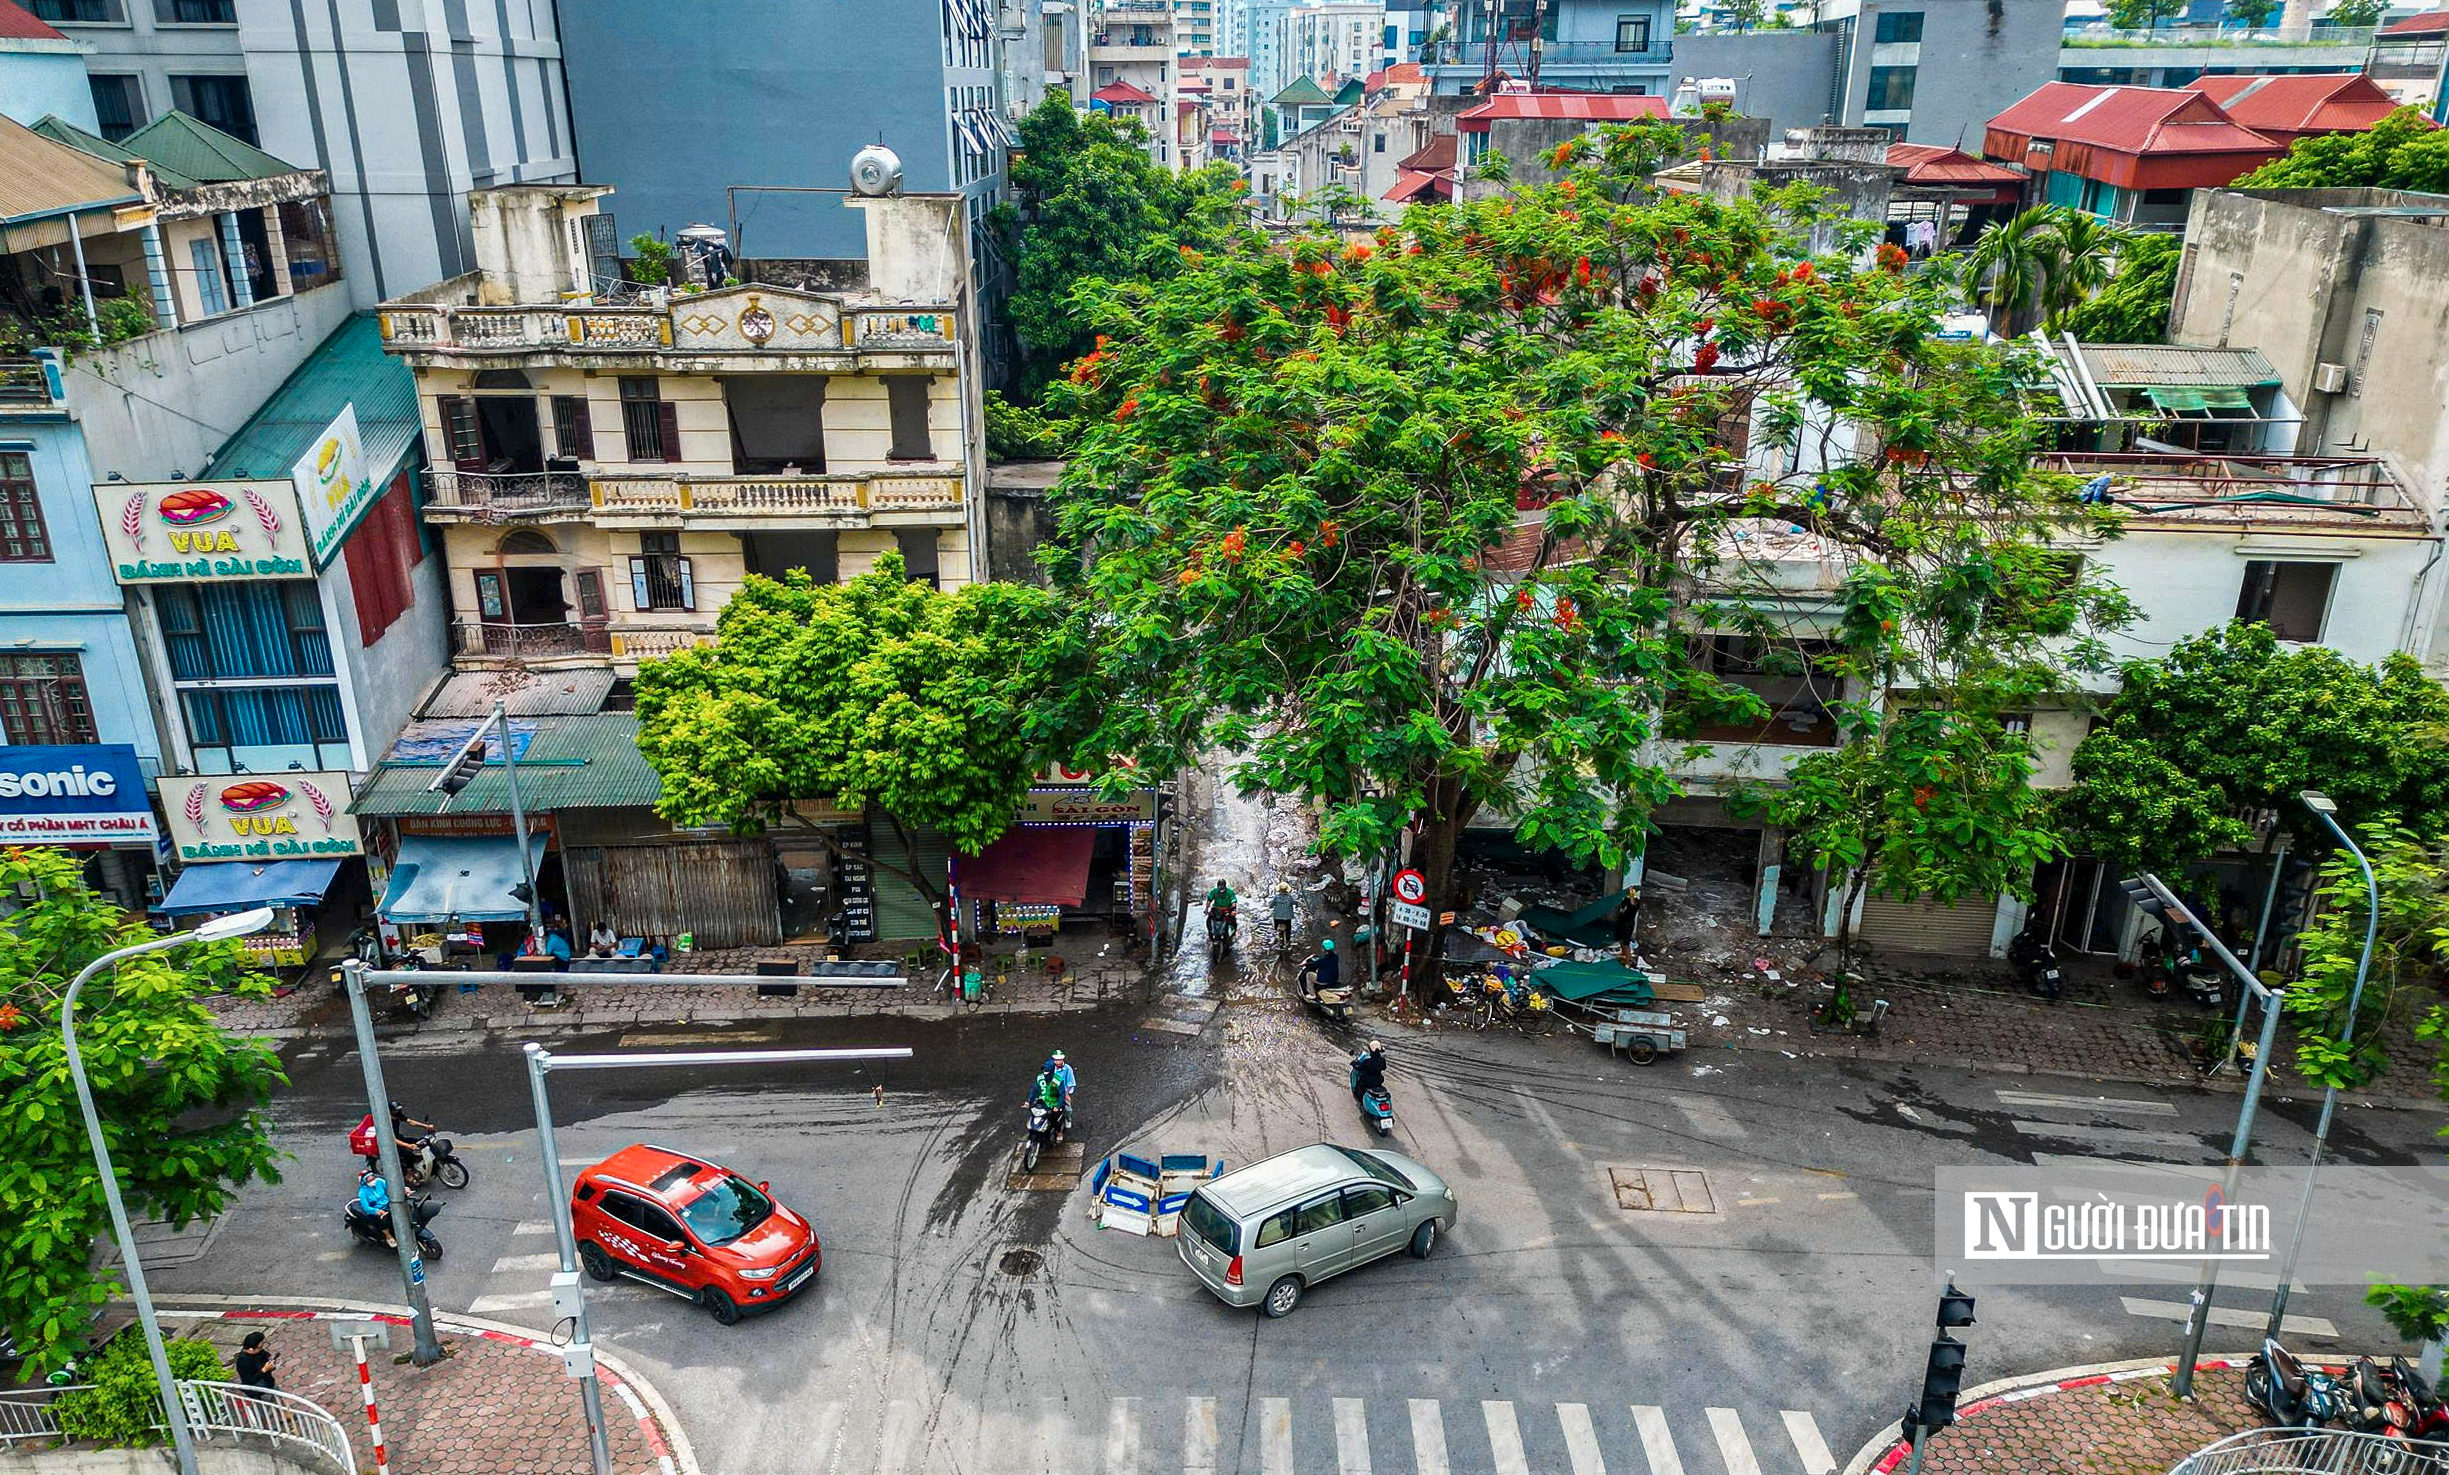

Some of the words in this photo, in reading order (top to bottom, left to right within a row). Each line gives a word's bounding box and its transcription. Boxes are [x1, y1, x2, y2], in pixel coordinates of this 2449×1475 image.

[168, 530, 240, 554] VUA
[119, 559, 184, 580] BÁNH
[185, 557, 212, 577] MÌ
[214, 556, 254, 576] SÀI
[255, 555, 304, 576] GÒN
[0, 764, 117, 798] sonic
[1052, 804, 1090, 814] SÀI
[1094, 804, 1141, 813] GÒN
[28, 817, 66, 832] PHẦN
[99, 818, 137, 831] CHÂU
[139, 817, 149, 830] Á
[228, 816, 299, 837] VUA
[181, 841, 242, 859] BÁNH
[245, 839, 270, 857] MÌ
[273, 839, 311, 856] SÀI
